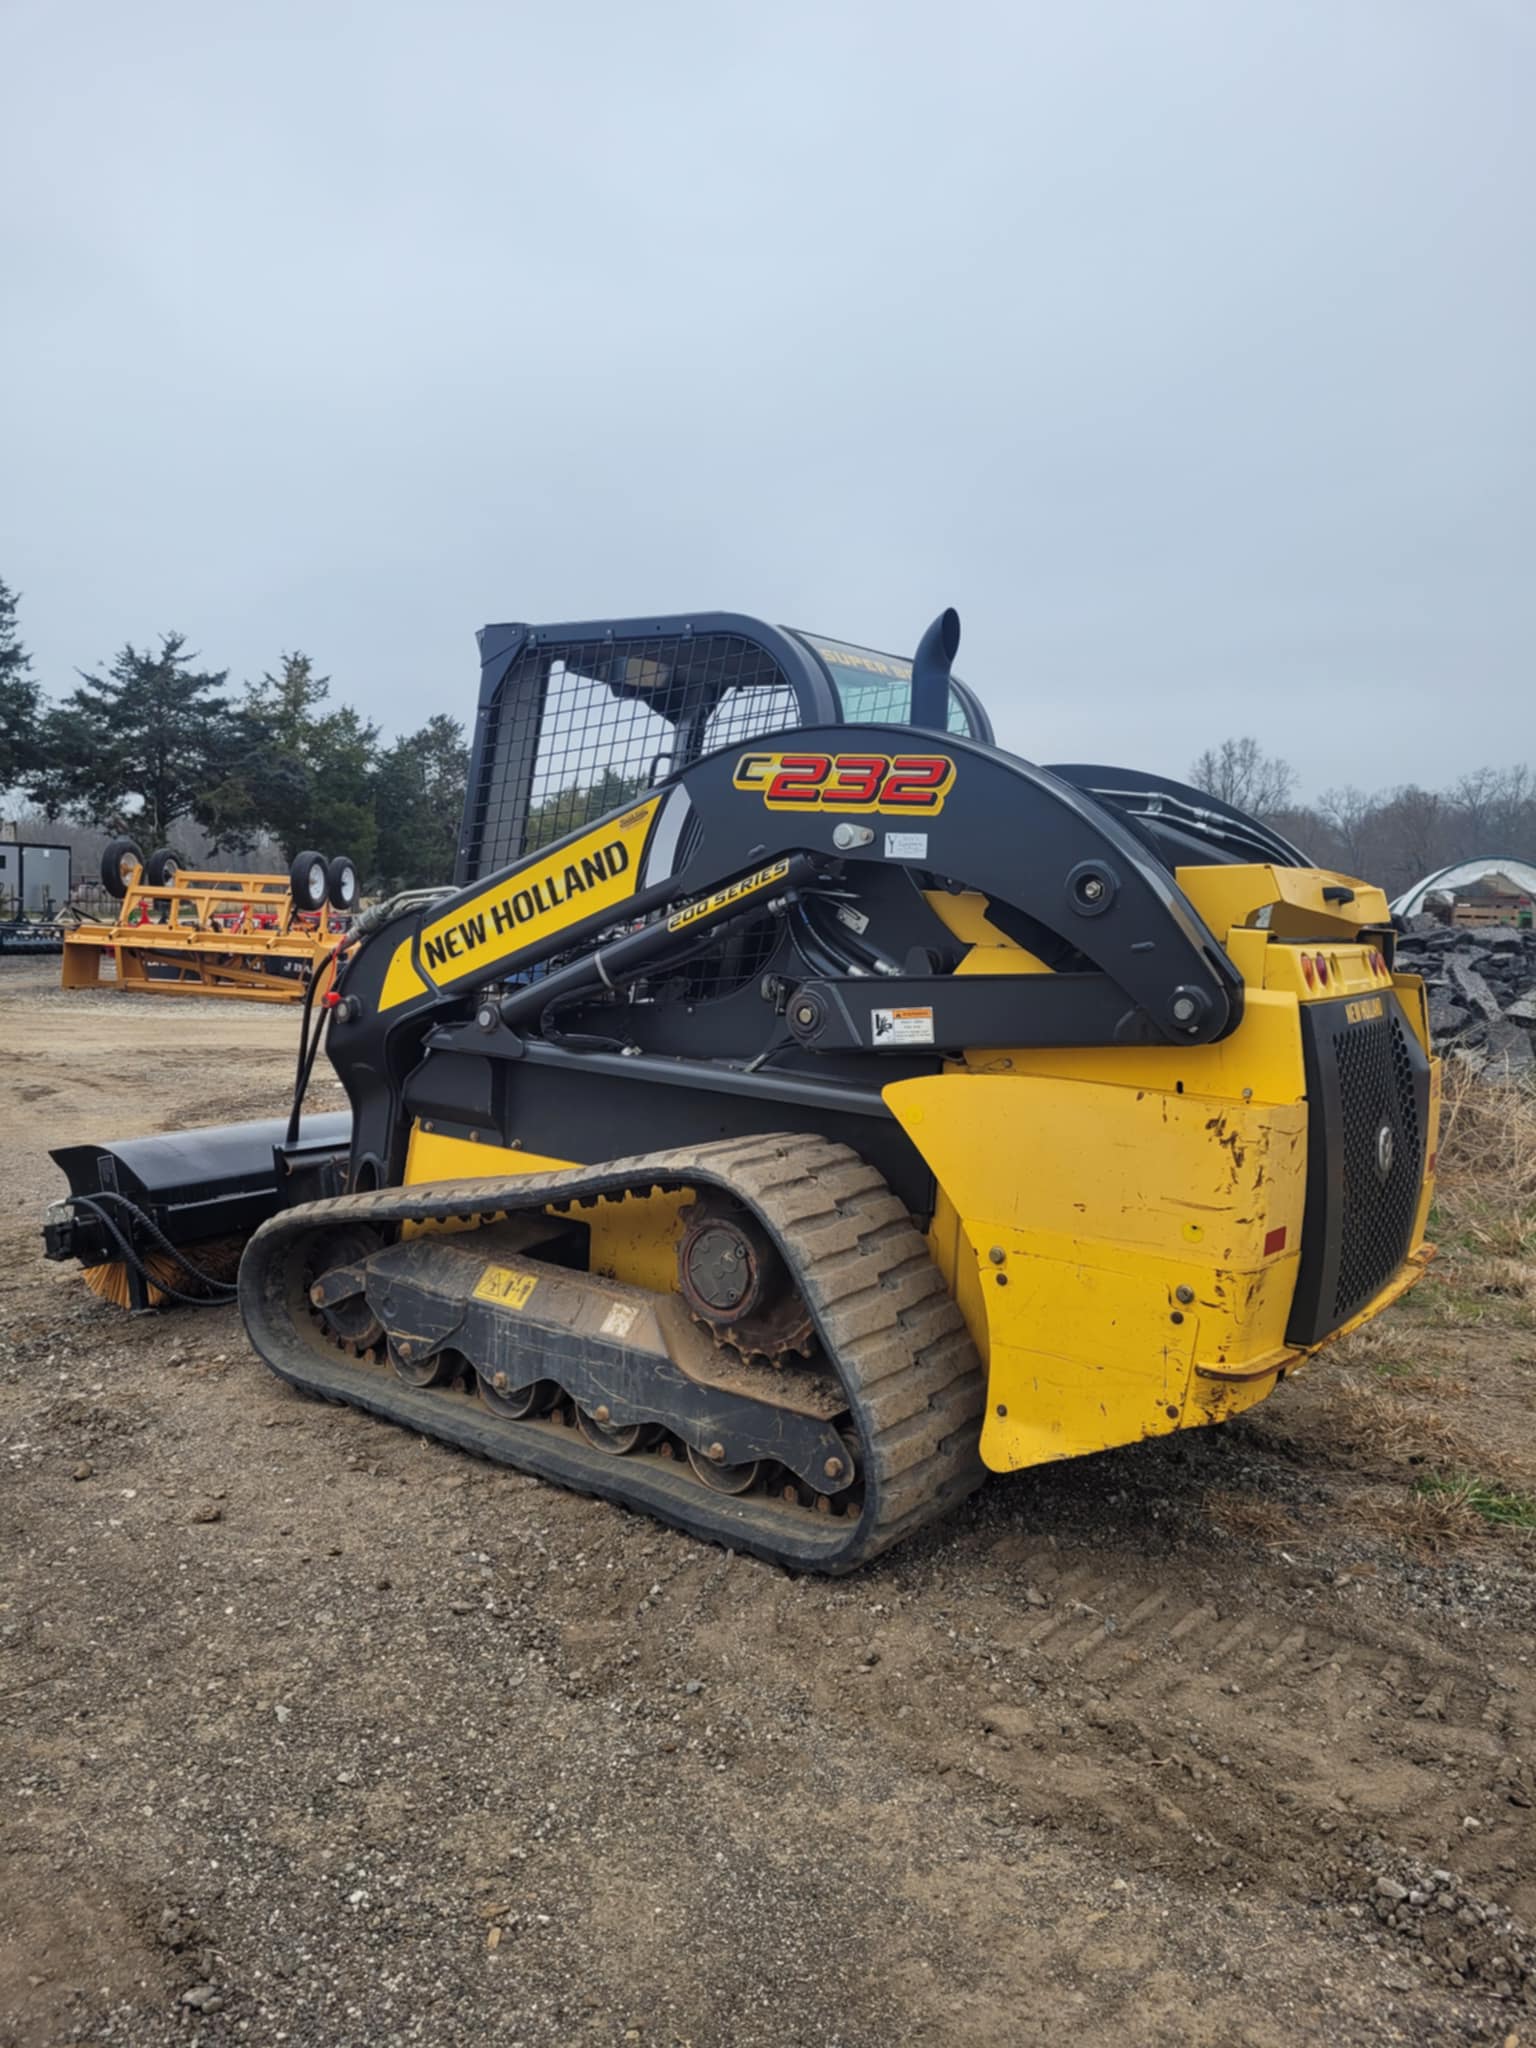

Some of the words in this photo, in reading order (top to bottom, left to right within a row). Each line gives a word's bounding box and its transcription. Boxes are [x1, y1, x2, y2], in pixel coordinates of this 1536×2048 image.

[820, 648, 888, 675] SUPER
[423, 913, 487, 970] NEW
[493, 839, 630, 935] HOLLAND
[669, 900, 709, 929] 200
[713, 861, 787, 907] SERIES
